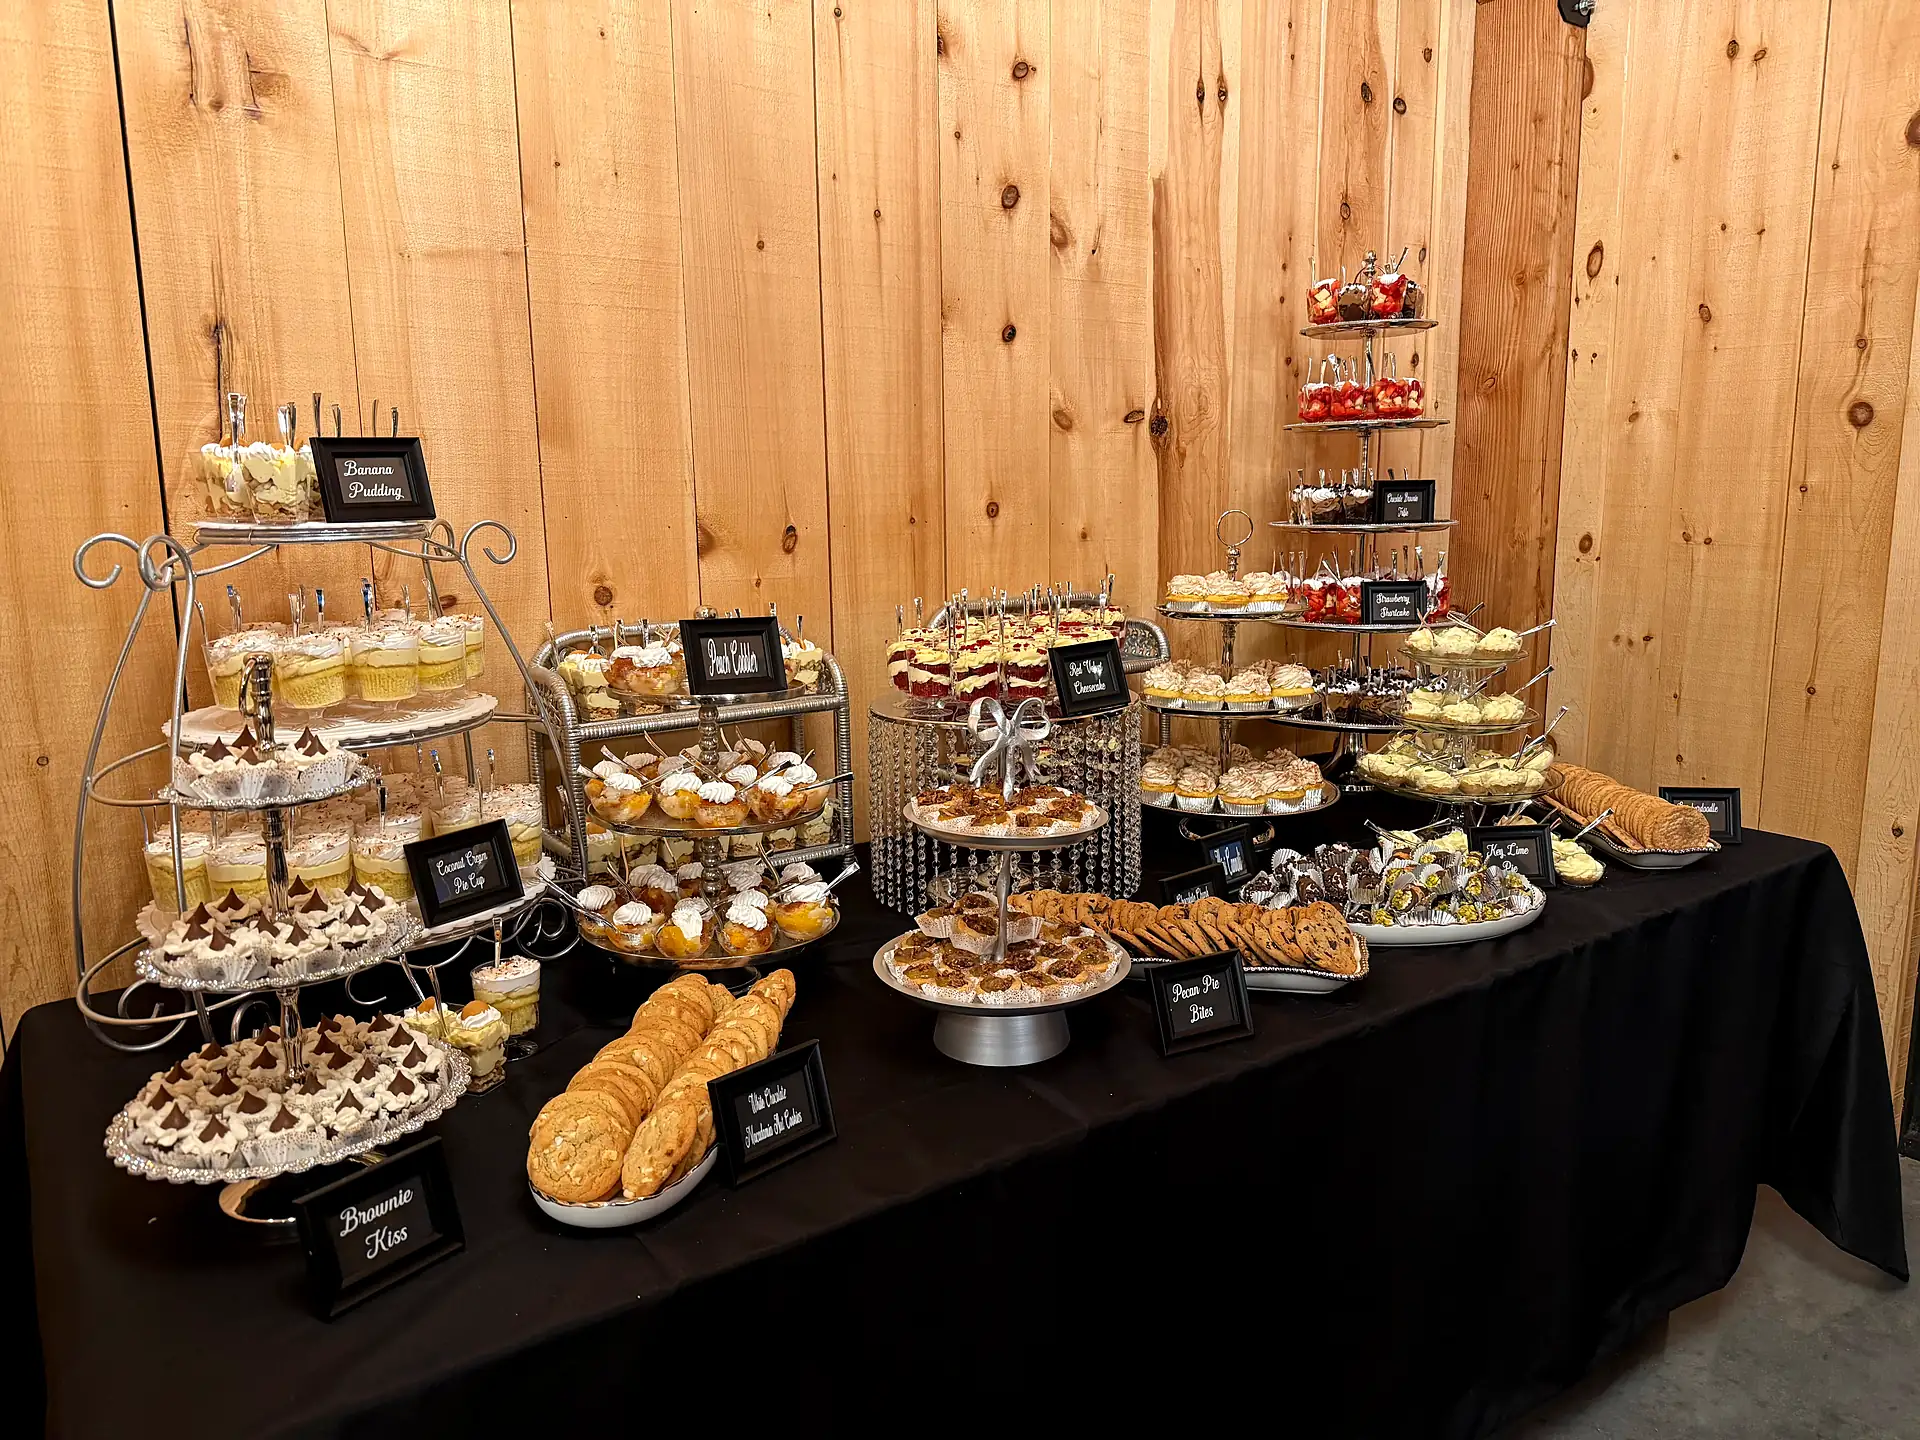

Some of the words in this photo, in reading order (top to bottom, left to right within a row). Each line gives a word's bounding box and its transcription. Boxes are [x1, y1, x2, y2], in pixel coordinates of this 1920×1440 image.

[344, 460, 394, 476] Banana
[349, 482, 404, 500] Pudding
[1376, 593, 1410, 605] Strawberry
[1380, 607, 1410, 618] Shortcake
[707, 638, 730, 677] Peach
[730, 640, 758, 675] Cobbler
[1069, 662, 1082, 677] Red
[1073, 679, 1106, 694] Cheesecake
[1486, 843, 1506, 859] Key
[1506, 842, 1529, 856] Lime
[436, 860, 465, 876] Coconut
[465, 850, 488, 866] Cream
[453, 877, 469, 894] Pie
[468, 872, 485, 889] Cup
[1172, 983, 1200, 1003] Pecan
[1202, 974, 1220, 993] Pie
[1189, 1003, 1214, 1023] Bites
[748, 1092, 765, 1114] White
[764, 1084, 787, 1108] Chocolate
[784, 1107, 803, 1129] Cookies
[340, 1189, 413, 1237] Brownie
[365, 1226, 408, 1259] Kiss
